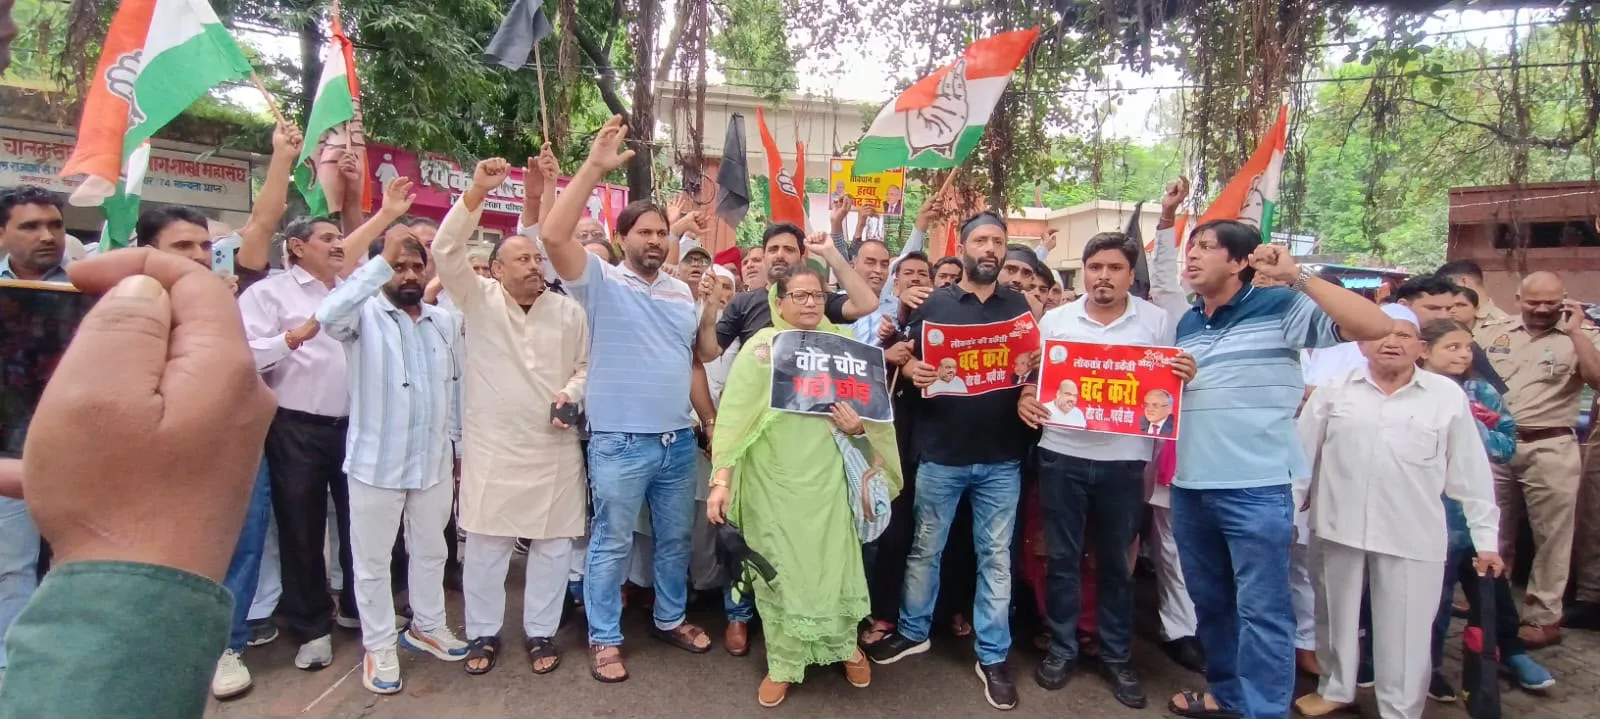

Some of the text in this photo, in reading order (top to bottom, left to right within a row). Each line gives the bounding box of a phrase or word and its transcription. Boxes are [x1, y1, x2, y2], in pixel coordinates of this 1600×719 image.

[201, 163, 248, 183] महासंघ
[856, 185, 877, 197] हत्या
[794, 346, 868, 377] वोट चोर
[958, 343, 1011, 371] बंद करो
[1073, 356, 1101, 369] लोकतंत्र
[1102, 358, 1114, 370] की
[1080, 370, 1140, 405] बंद करो
